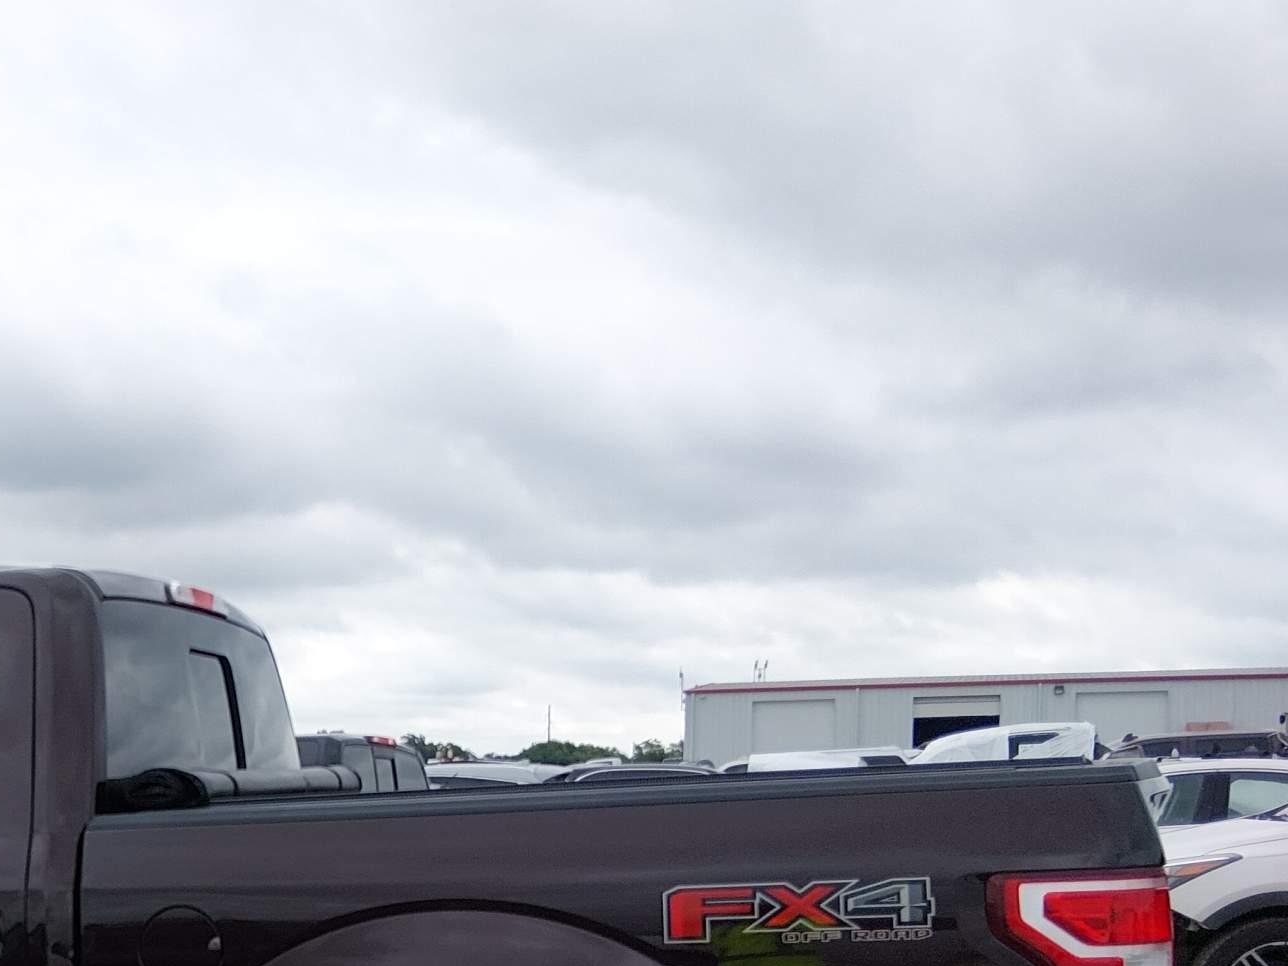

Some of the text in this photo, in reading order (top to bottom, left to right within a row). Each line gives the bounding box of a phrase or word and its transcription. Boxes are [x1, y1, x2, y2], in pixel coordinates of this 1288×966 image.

[663, 877, 935, 944] FX4
[781, 929, 934, 944] OFF ROAD
